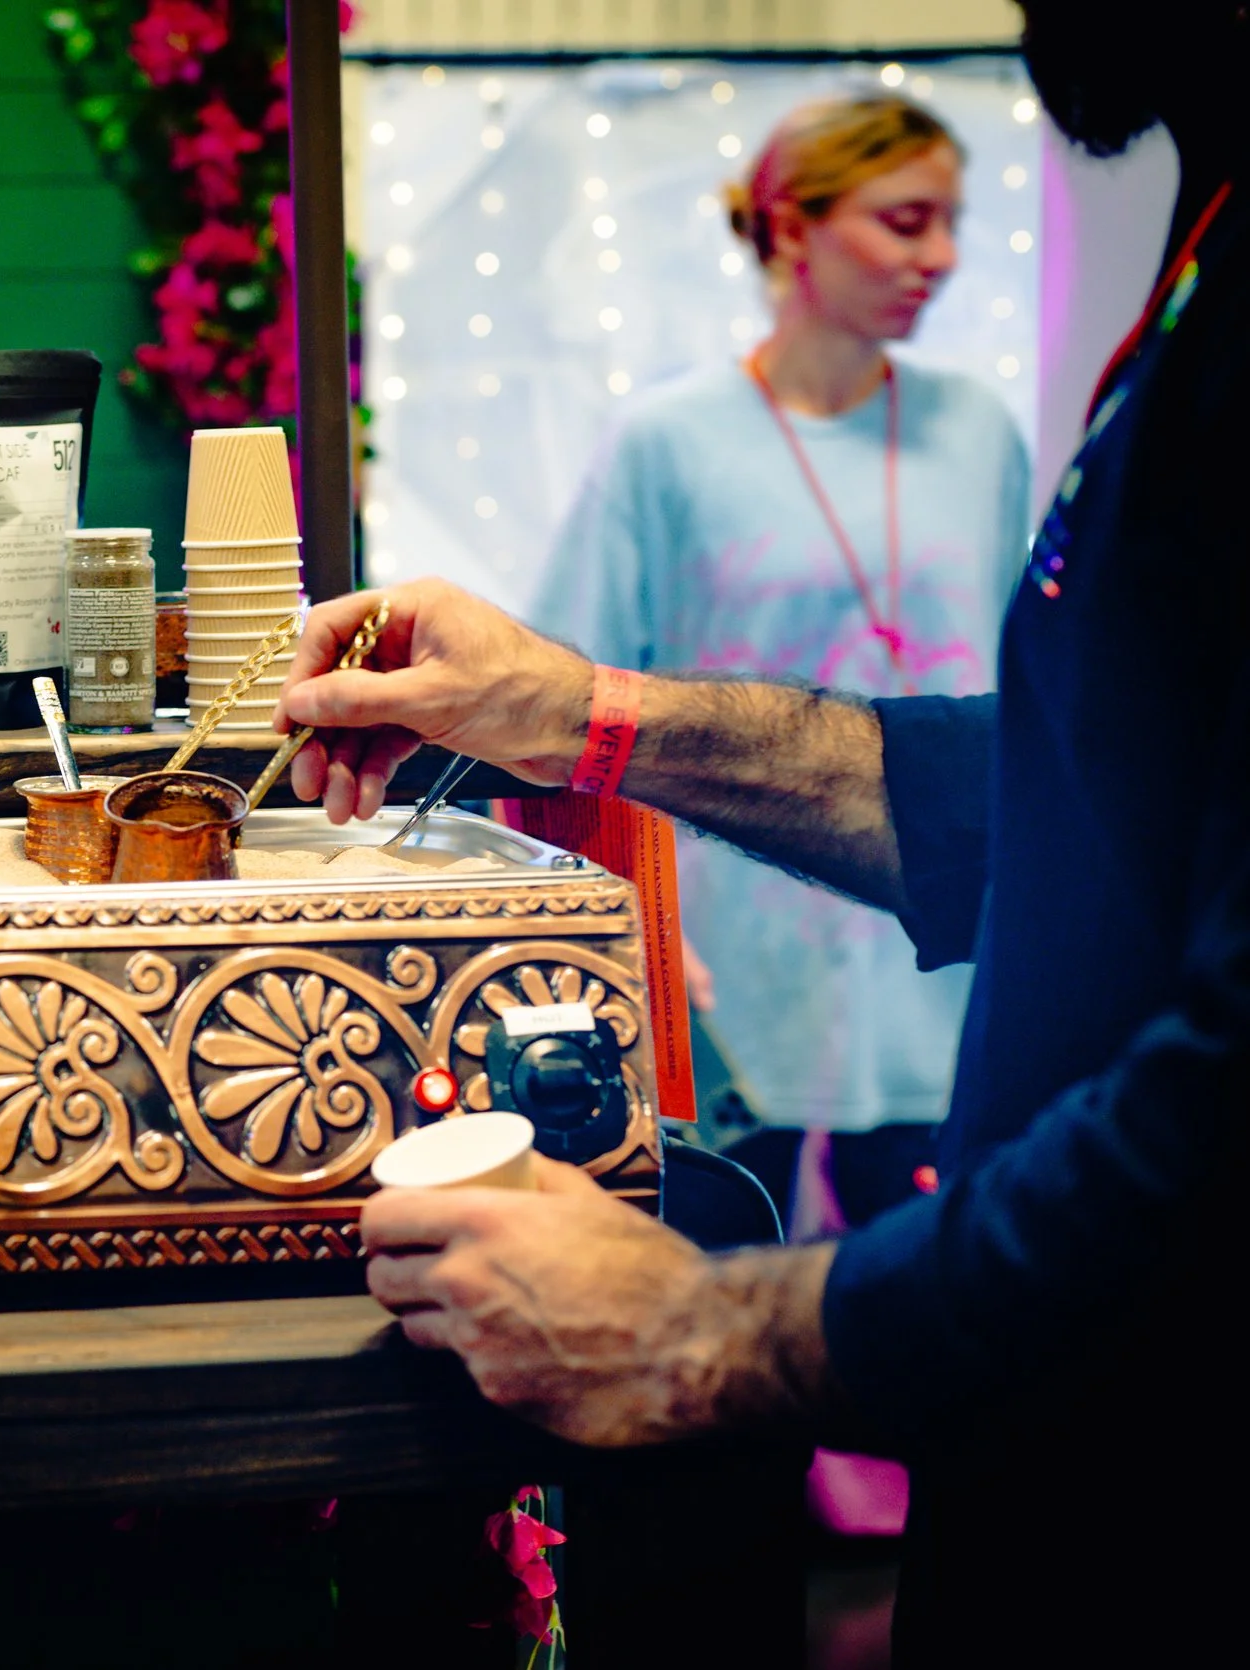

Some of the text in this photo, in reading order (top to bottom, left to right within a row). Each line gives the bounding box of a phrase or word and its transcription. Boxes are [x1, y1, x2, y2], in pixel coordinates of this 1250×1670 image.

[53, 440, 76, 471] 512
[591, 707, 625, 776] EVENT
[662, 969, 672, 1018] CANNOT
